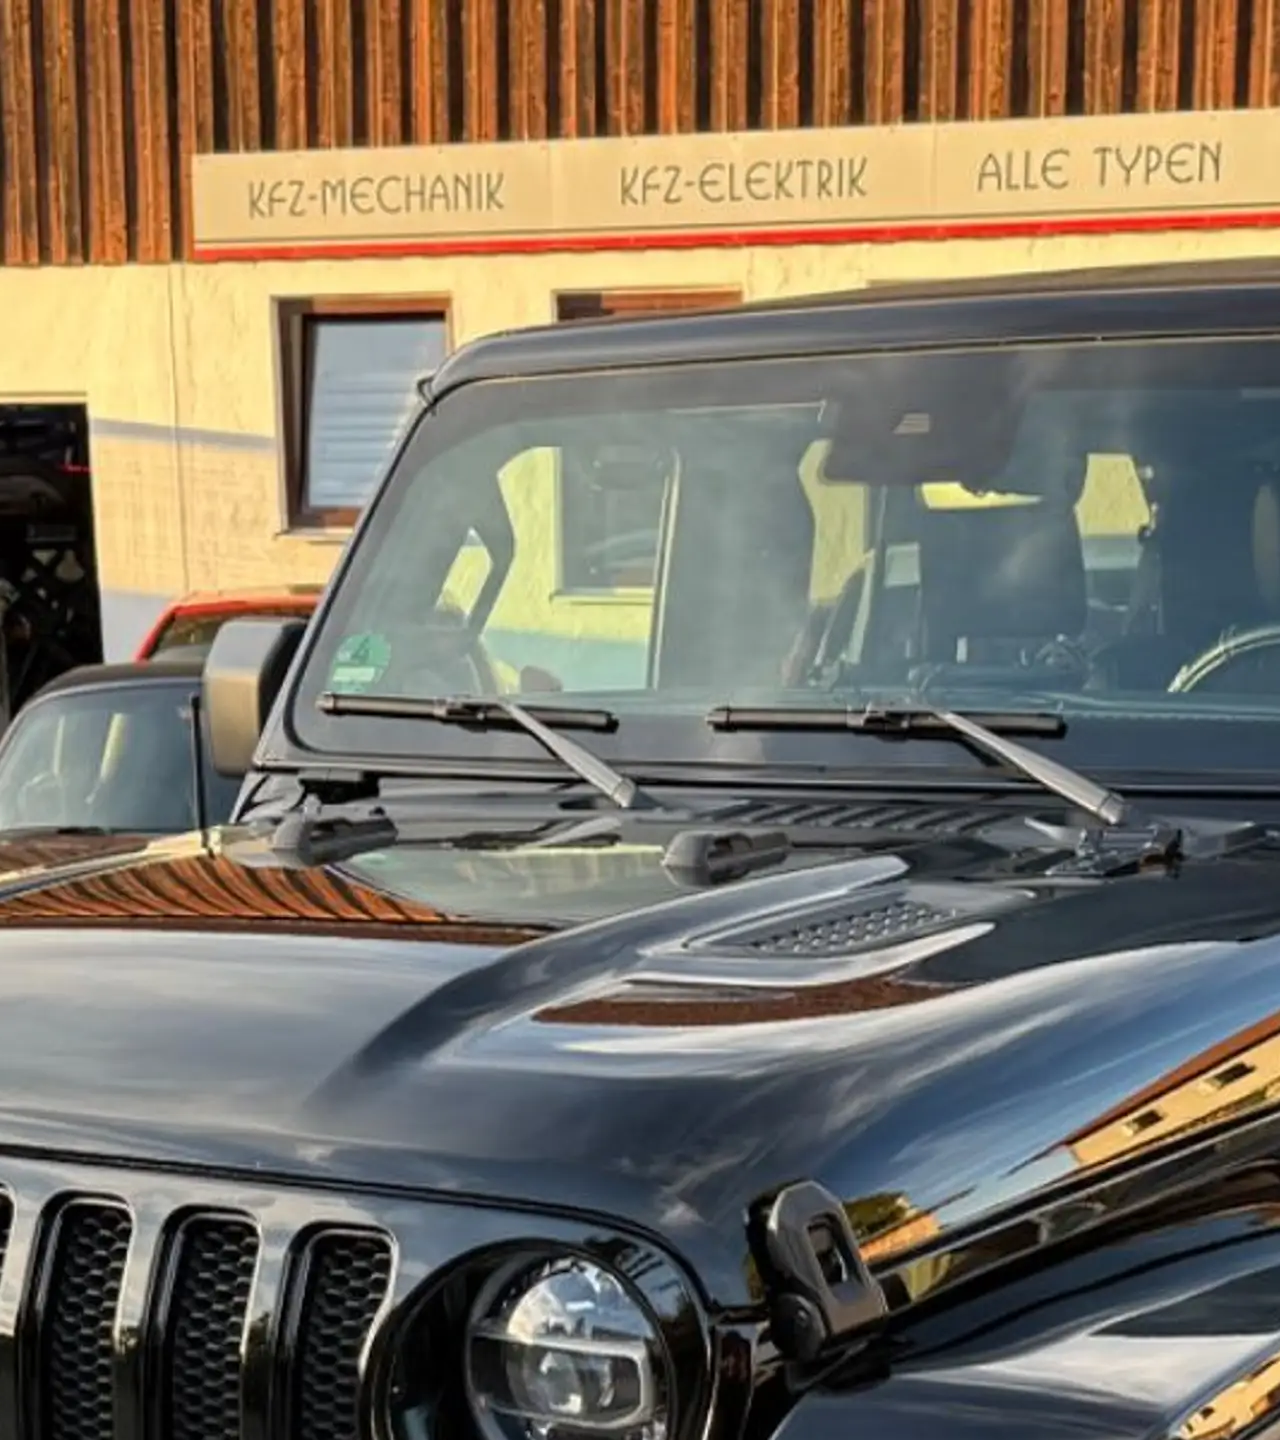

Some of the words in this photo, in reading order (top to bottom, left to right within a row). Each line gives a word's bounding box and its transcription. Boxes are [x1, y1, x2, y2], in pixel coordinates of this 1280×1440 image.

[619, 156, 869, 206] KFZ-ELEKTRIK
[977, 147, 1070, 191] ALLE
[1093, 141, 1223, 187] TYPEN
[248, 171, 505, 219] KFZ-MECHANIK
